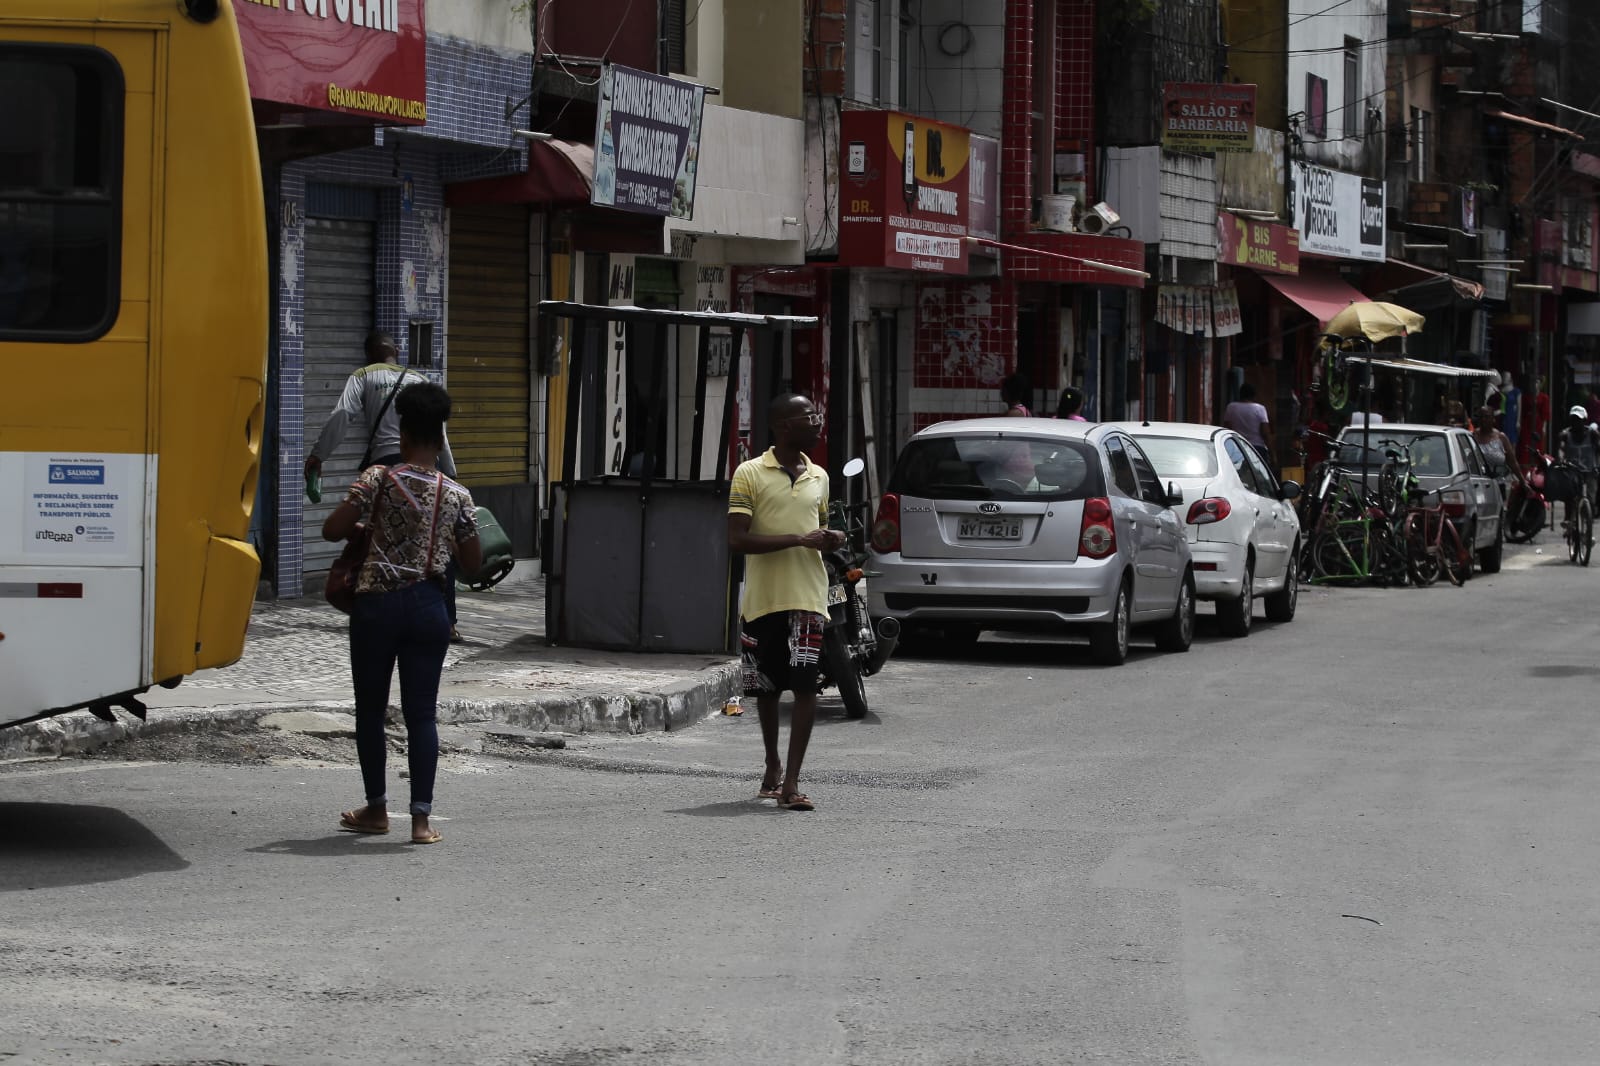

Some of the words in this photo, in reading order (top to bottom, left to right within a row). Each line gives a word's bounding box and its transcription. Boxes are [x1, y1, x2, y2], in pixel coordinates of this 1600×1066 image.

[651, 80, 693, 129] VARIEDADES
[1181, 102, 1226, 117] SALÃO
[1229, 106, 1238, 118] E
[1168, 118, 1249, 132] BARBEARIA
[926, 128, 946, 178] DR.
[1311, 168, 1334, 206] AGRO
[851, 199, 874, 213] DR.
[918, 185, 958, 216] SMARTPHONE
[1311, 206, 1338, 238] ROCHA
[1361, 198, 1382, 233] Quartz
[1254, 225, 1270, 245] BIS
[1248, 247, 1277, 267] CARNE
[33, 492, 80, 501] INFORMAÇÕES,
[81, 492, 119, 500] SUGESTÕES
[45, 501, 92, 509] RECLAMAÇÕES
[83, 509, 112, 518] PÚBLICO.
